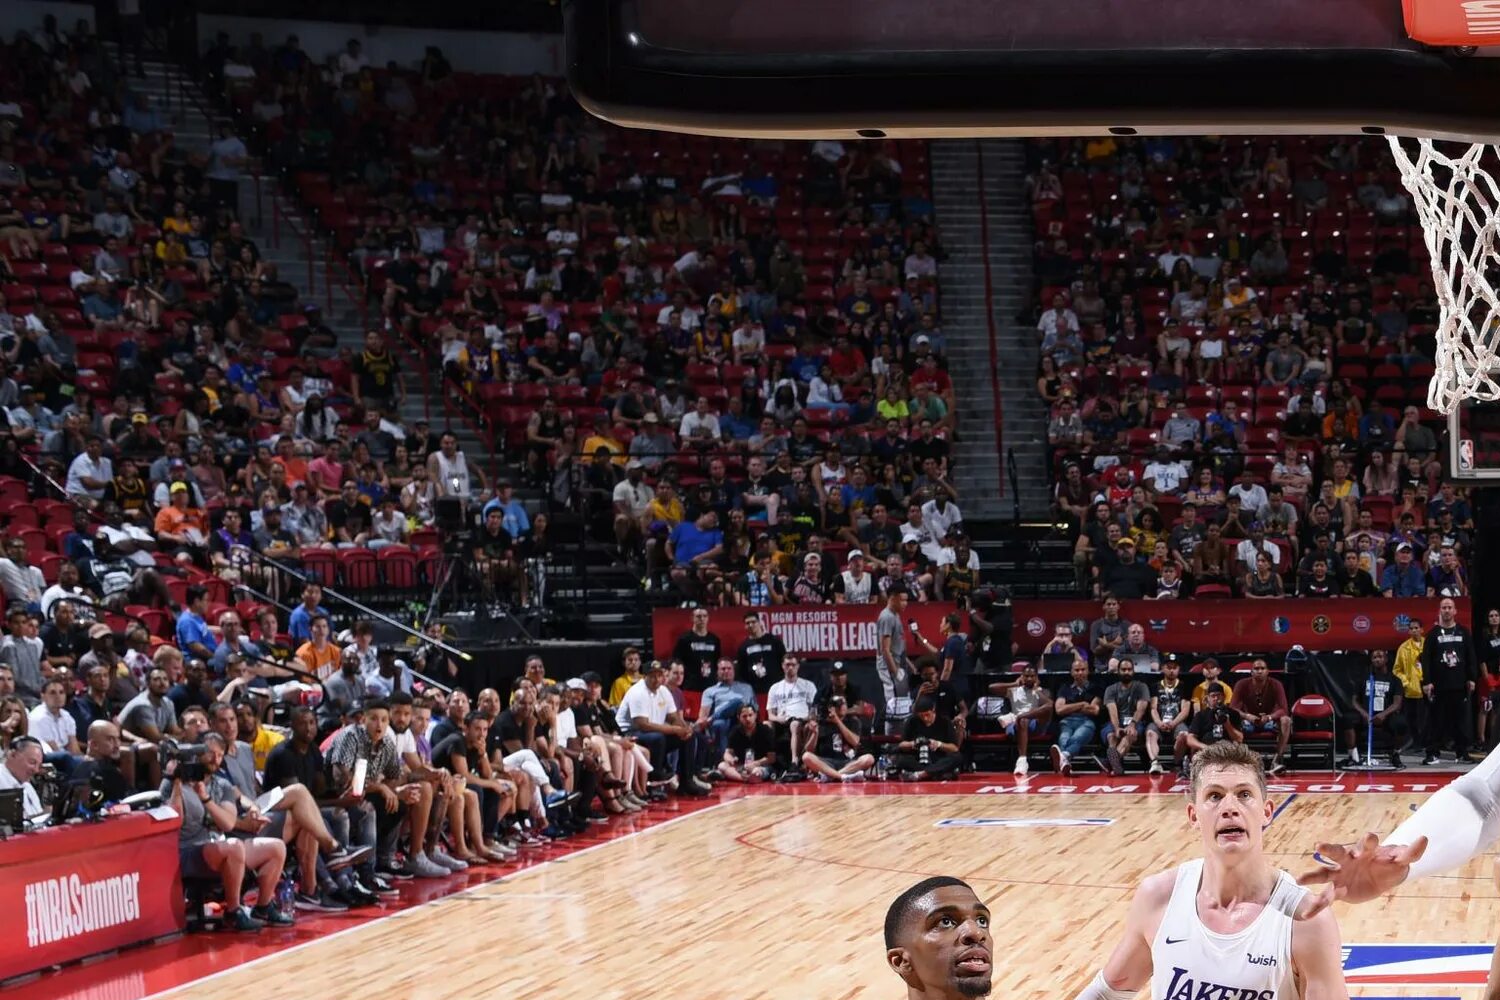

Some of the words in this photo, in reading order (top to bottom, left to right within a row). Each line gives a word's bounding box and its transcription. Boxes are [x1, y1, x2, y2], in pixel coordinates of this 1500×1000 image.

[771, 612, 793, 622] MGM
[796, 611, 838, 622] RESORTS
[976, 785, 1140, 793] MGM
[25, 871, 140, 948] #NBASummer
[1247, 952, 1277, 967] wish
